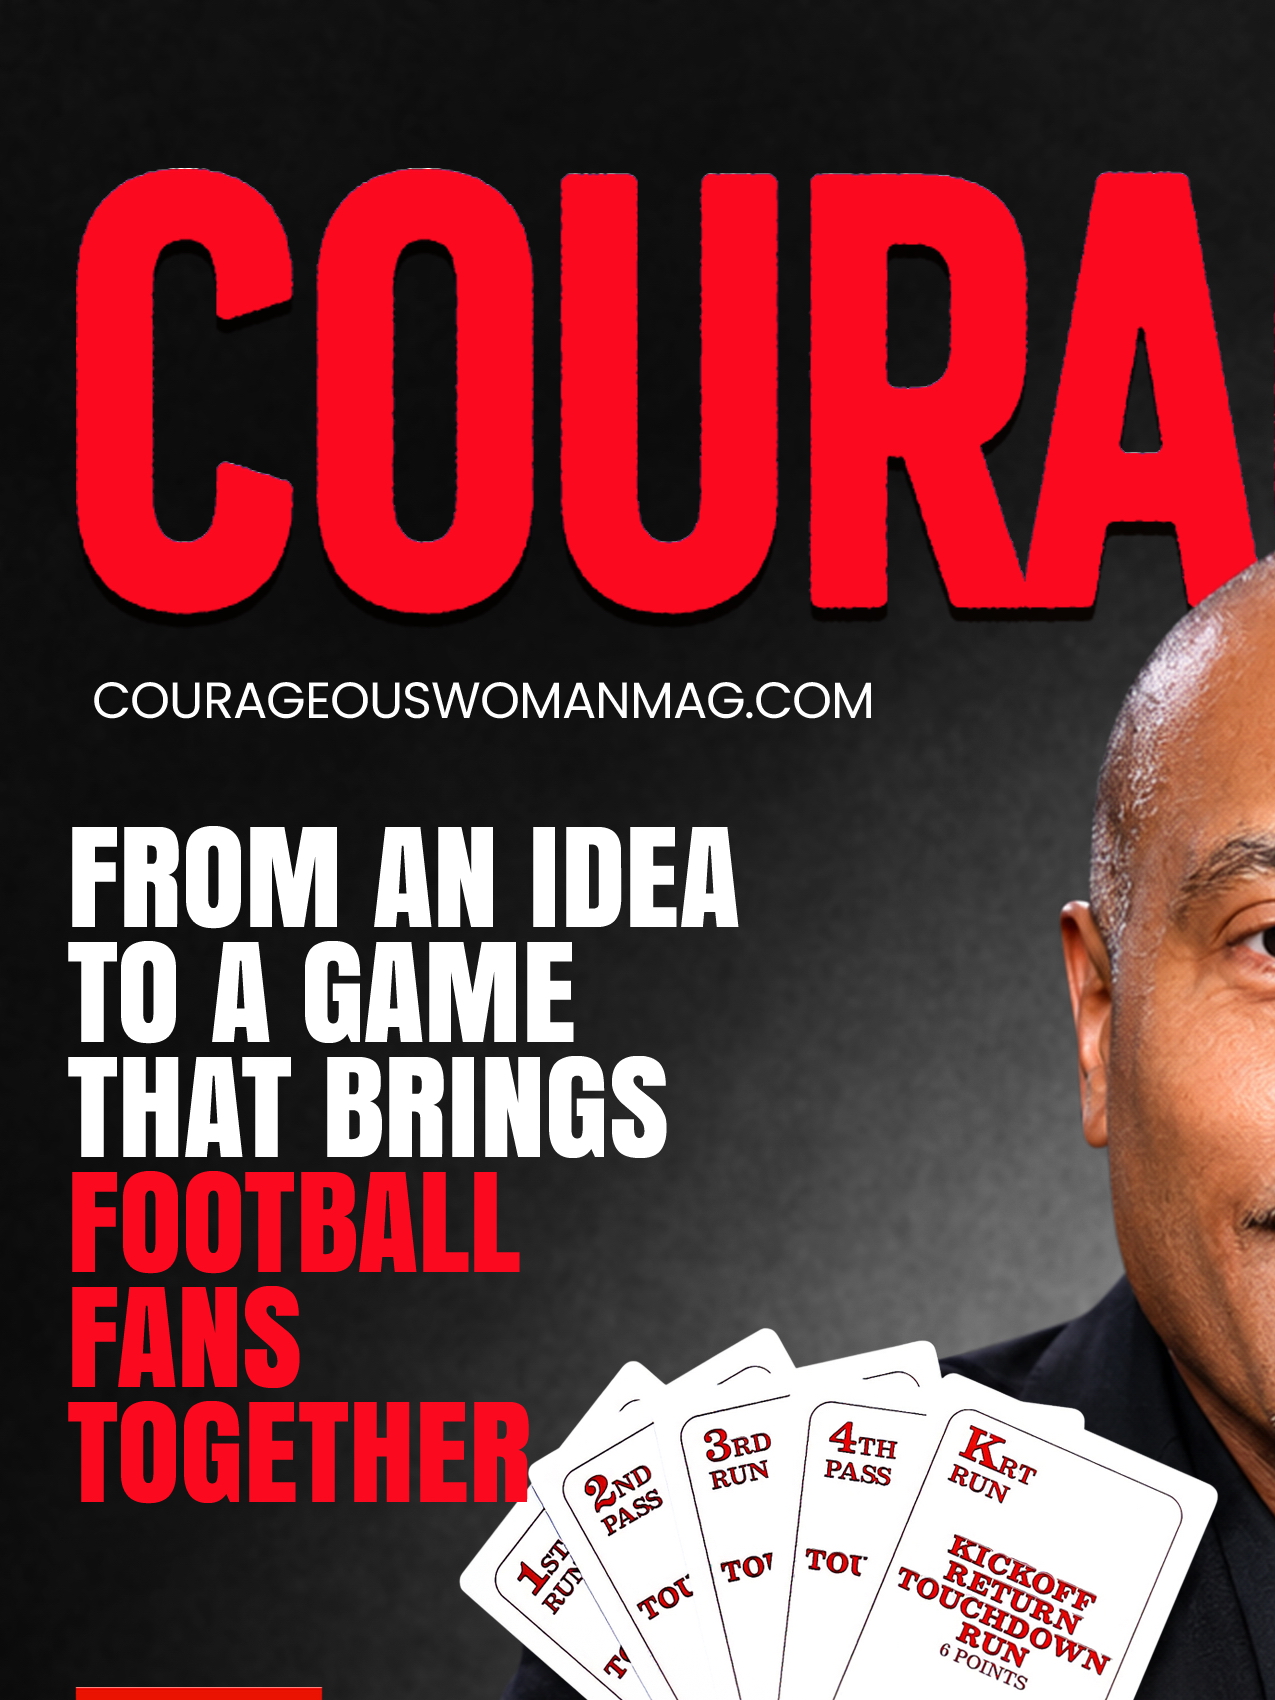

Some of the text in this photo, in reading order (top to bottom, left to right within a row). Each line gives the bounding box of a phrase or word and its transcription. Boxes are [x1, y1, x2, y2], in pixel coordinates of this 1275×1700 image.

[703, 1428, 772, 1462] 3RD
[829, 1421, 898, 1460] 4TH
[958, 1425, 1037, 1485] KRT
[584, 1465, 652, 1513] 2ND
[709, 1460, 769, 1490] RUN
[824, 1459, 892, 1487] PASS
[947, 1464, 1011, 1503] RUN
[601, 1489, 663, 1536] PASS
[517, 1539, 570, 1596] 1ST
[947, 1534, 1097, 1613] KICKOFF
[898, 1566, 1113, 1676] TOUCHDOWN
[943, 1560, 1083, 1636] RETURN
[939, 1642, 1029, 1692] 6 POINTS
[955, 1621, 1031, 1669] RUN
